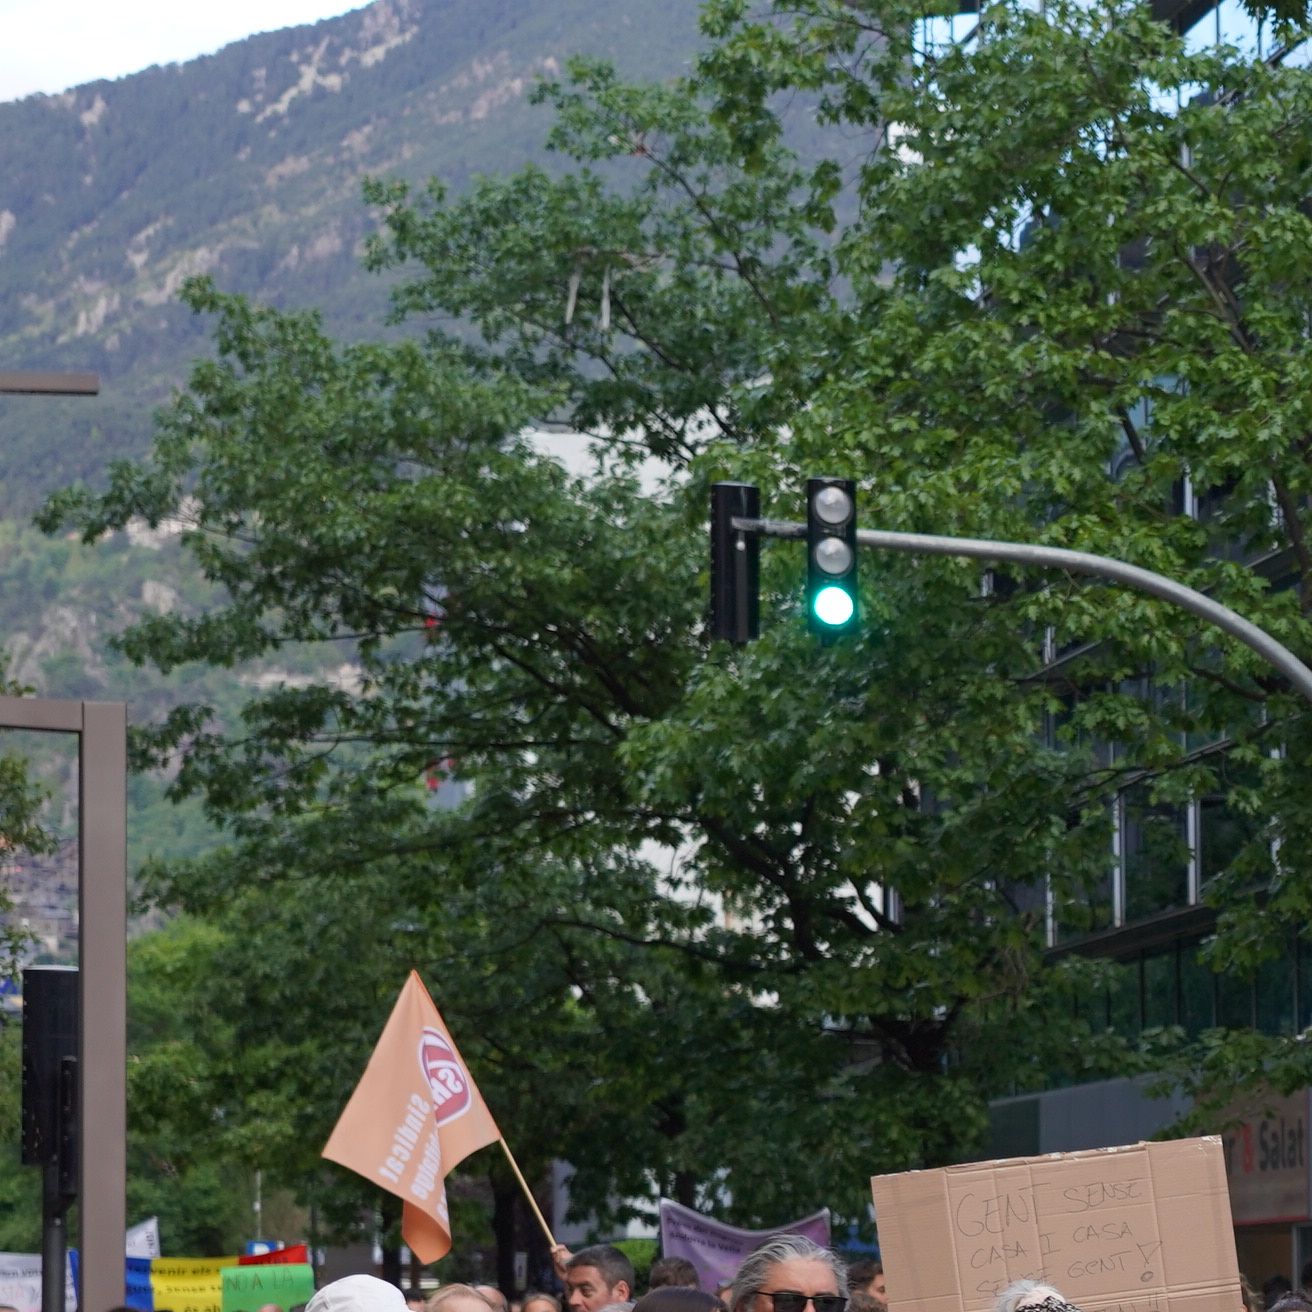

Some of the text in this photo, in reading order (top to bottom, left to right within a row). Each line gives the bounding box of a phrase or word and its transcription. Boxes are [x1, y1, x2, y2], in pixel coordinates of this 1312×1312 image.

[956, 1179, 1144, 1237] GENT SENSE
[970, 1241, 1027, 1269] CASA
[1072, 1222, 1133, 1243] CASA
